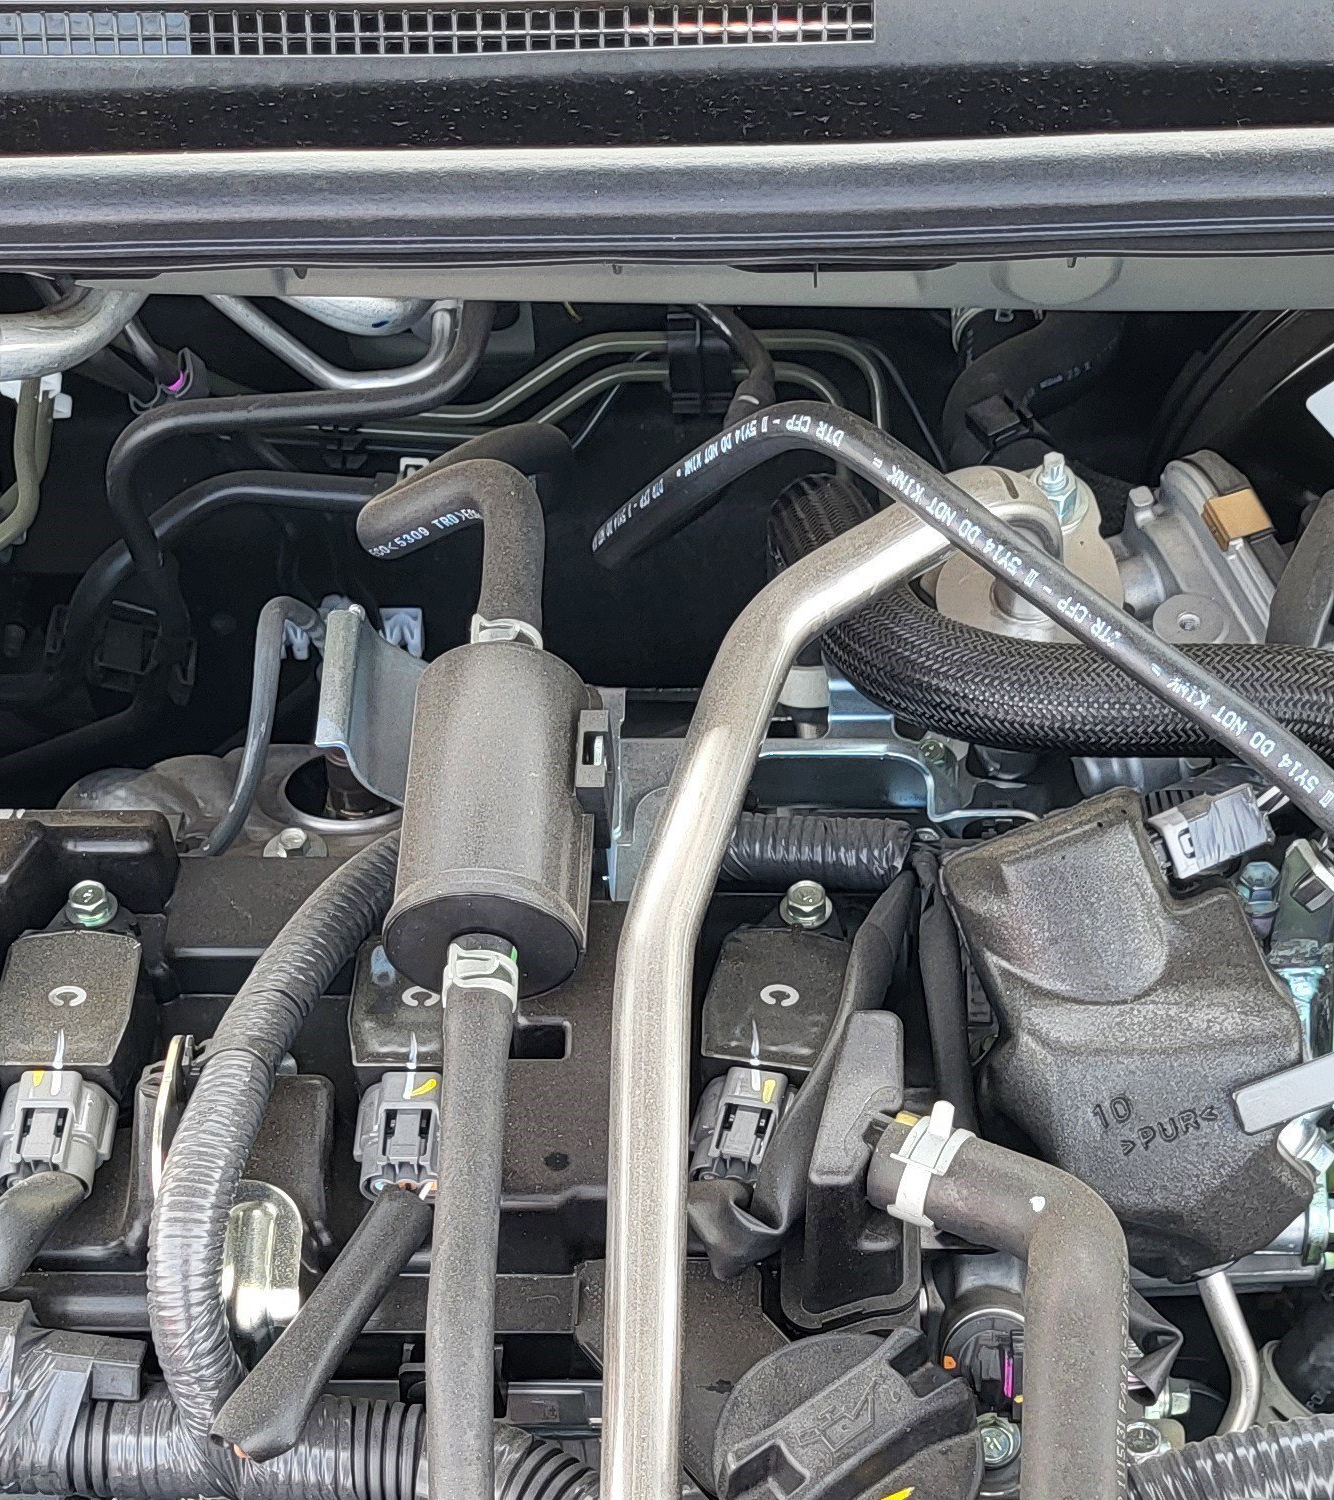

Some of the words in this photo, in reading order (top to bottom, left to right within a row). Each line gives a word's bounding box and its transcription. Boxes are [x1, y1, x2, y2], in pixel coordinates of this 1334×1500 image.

[926, 496, 956, 527] NOT
[959, 519, 979, 542] DO
[1212, 706, 1249, 737] NOT
[1249, 732, 1276, 757] DO
[1278, 752, 1320, 795] 5Y14
[1092, 1097, 1133, 1130] 10
